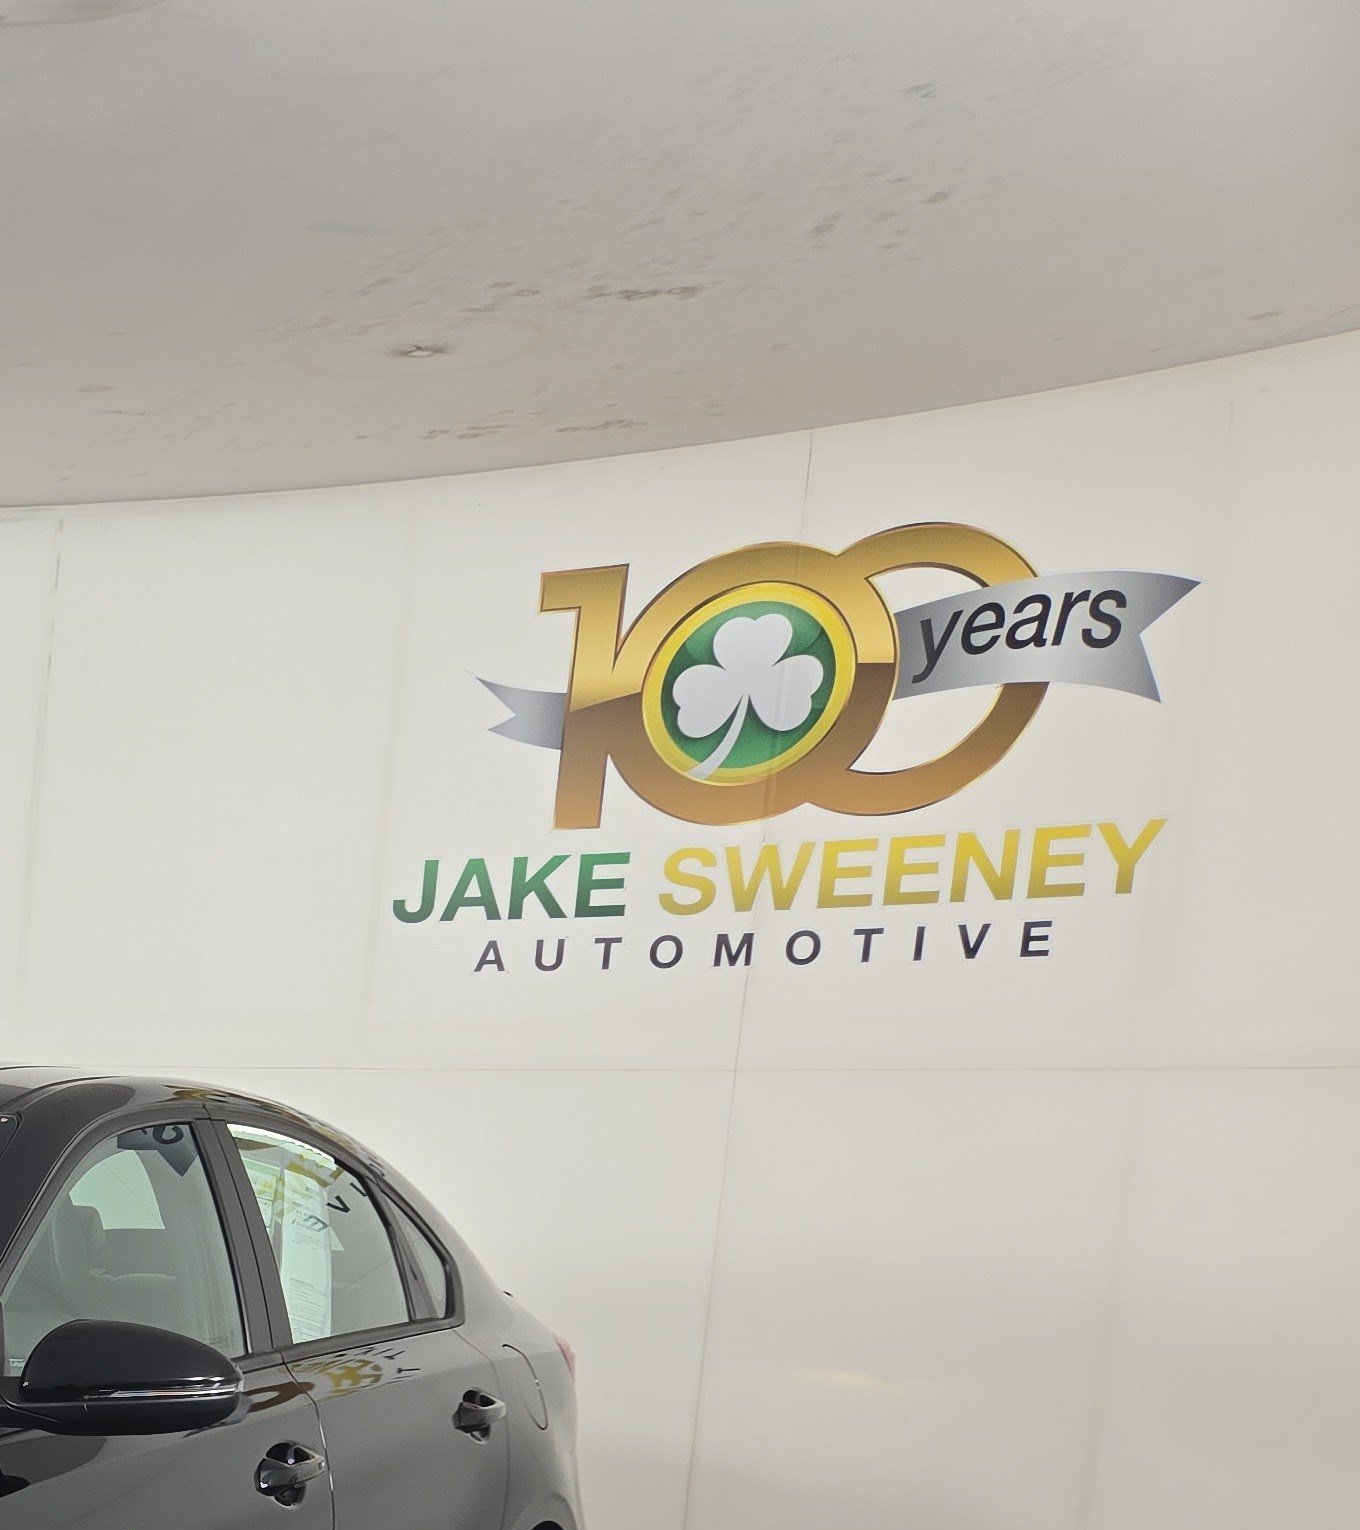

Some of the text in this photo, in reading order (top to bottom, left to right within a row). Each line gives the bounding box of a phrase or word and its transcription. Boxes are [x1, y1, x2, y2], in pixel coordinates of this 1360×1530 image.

[538, 521, 1127, 830] 100 years
[393, 818, 1166, 924] JAKE SWEENEY
[474, 920, 1054, 973] AUTOMOTIVE
